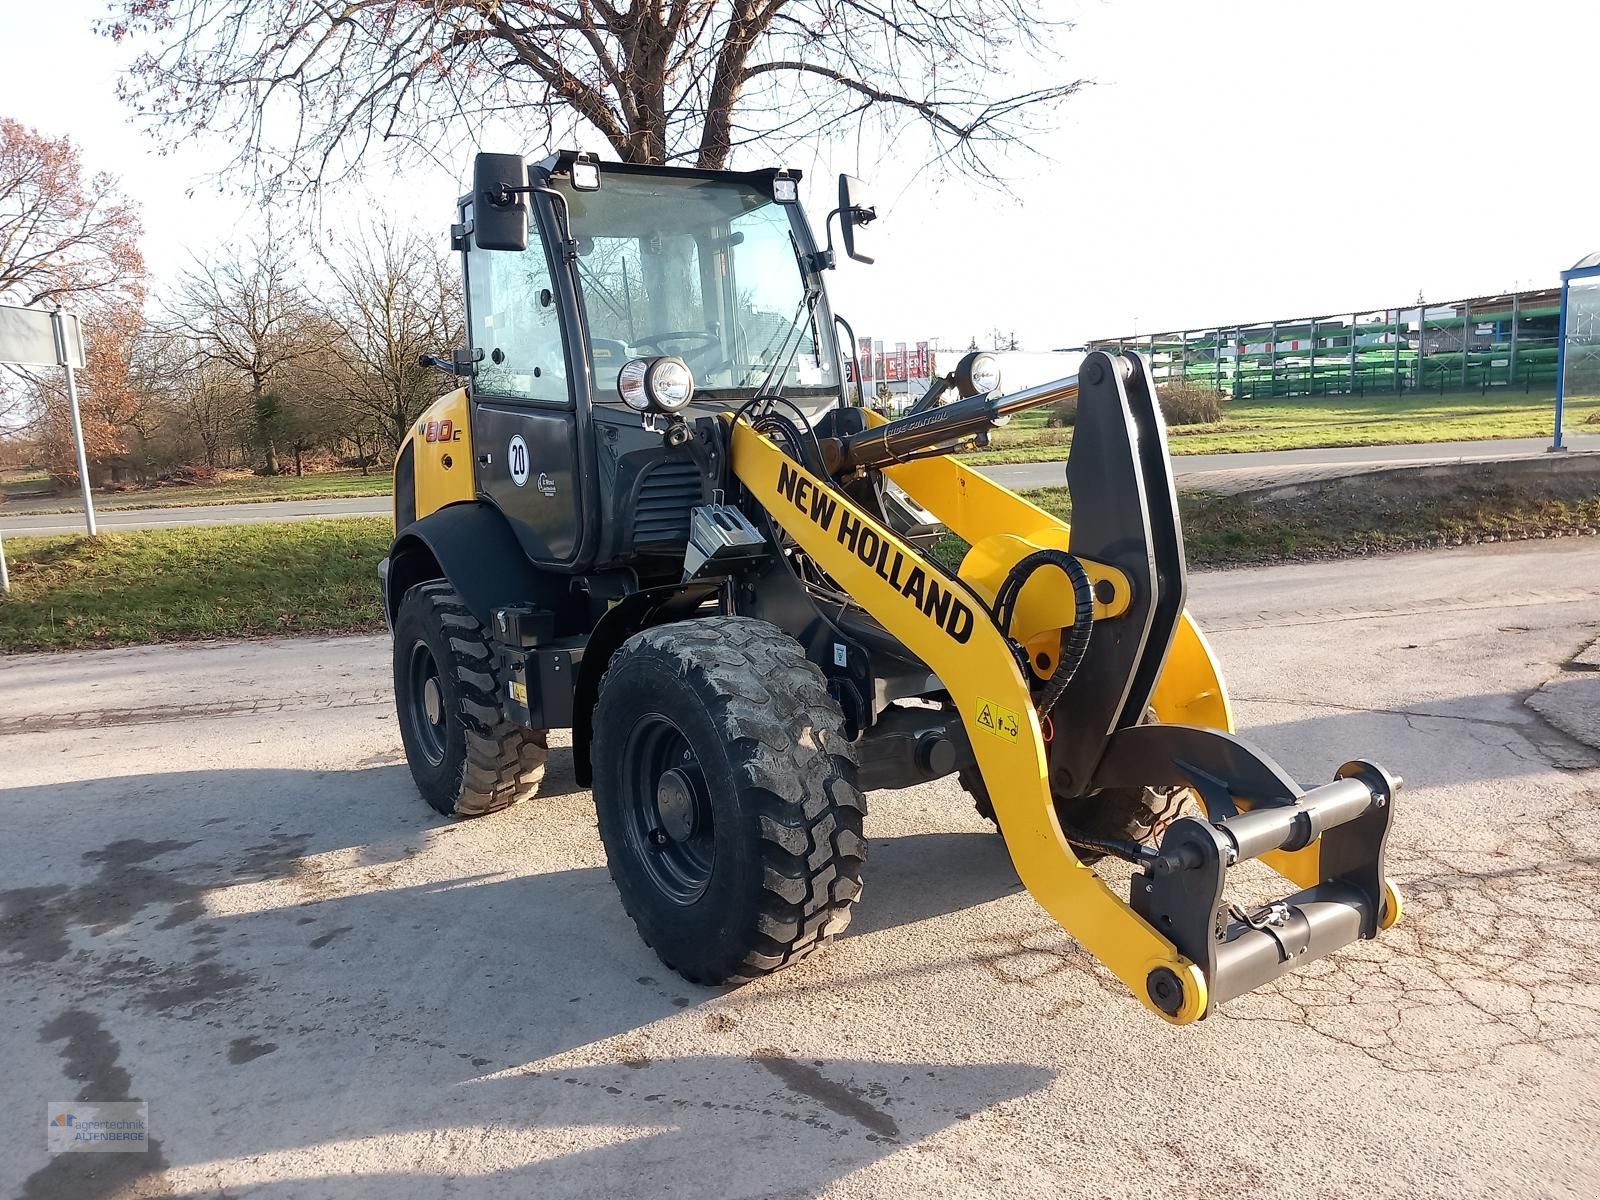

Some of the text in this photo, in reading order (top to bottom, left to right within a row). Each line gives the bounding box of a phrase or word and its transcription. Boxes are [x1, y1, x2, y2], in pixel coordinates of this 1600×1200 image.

[512, 444, 525, 475] 20
[777, 462, 974, 644] NEW HOLLAND
